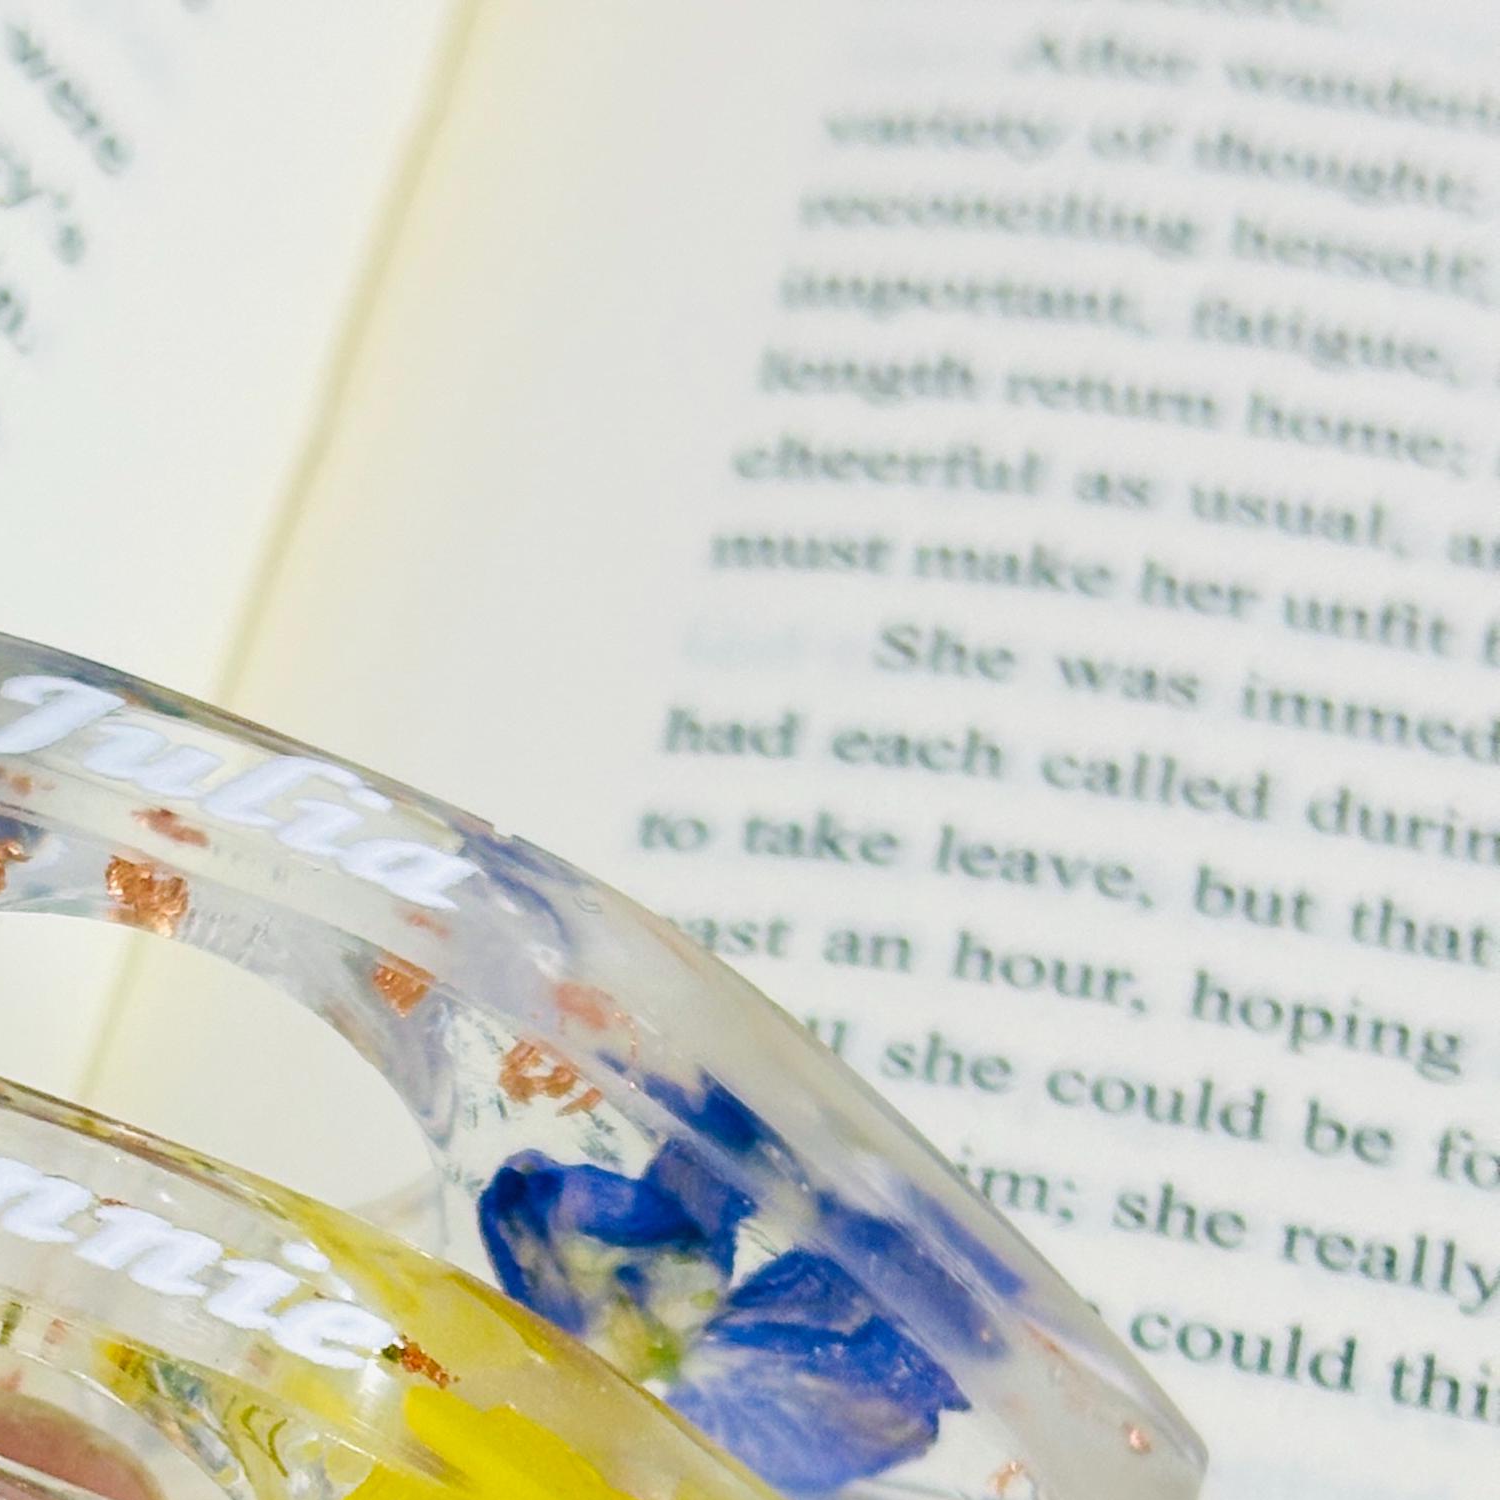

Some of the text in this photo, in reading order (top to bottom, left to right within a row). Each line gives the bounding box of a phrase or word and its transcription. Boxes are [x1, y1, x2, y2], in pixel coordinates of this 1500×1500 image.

[1006, 370, 1222, 430] return
[730, 430, 1048, 496] cheerful
[1073, 468, 1156, 510] as
[709, 532, 892, 574] must
[912, 542, 1117, 598] make
[1136, 557, 1258, 620] her
[1281, 595, 1458, 660] unfit
[874, 621, 1018, 684] She
[1056, 655, 1202, 708] was
[660, 704, 804, 760] had
[828, 726, 1007, 781] each
[1040, 750, 1272, 823] called
[636, 808, 1496, 970] to take leave, but that
[822, 927, 915, 975] an
[950, 928, 1149, 1016] hour,
[1189, 966, 1469, 1084] hoping
[880, 1029, 1015, 1095] she
[1044, 1068, 1269, 1144] could
[1301, 1095, 1396, 1169] be
[1110, 1181, 1249, 1252] she
[1279, 1222, 1500, 1317] really
[1128, 1312, 1360, 1397] could
